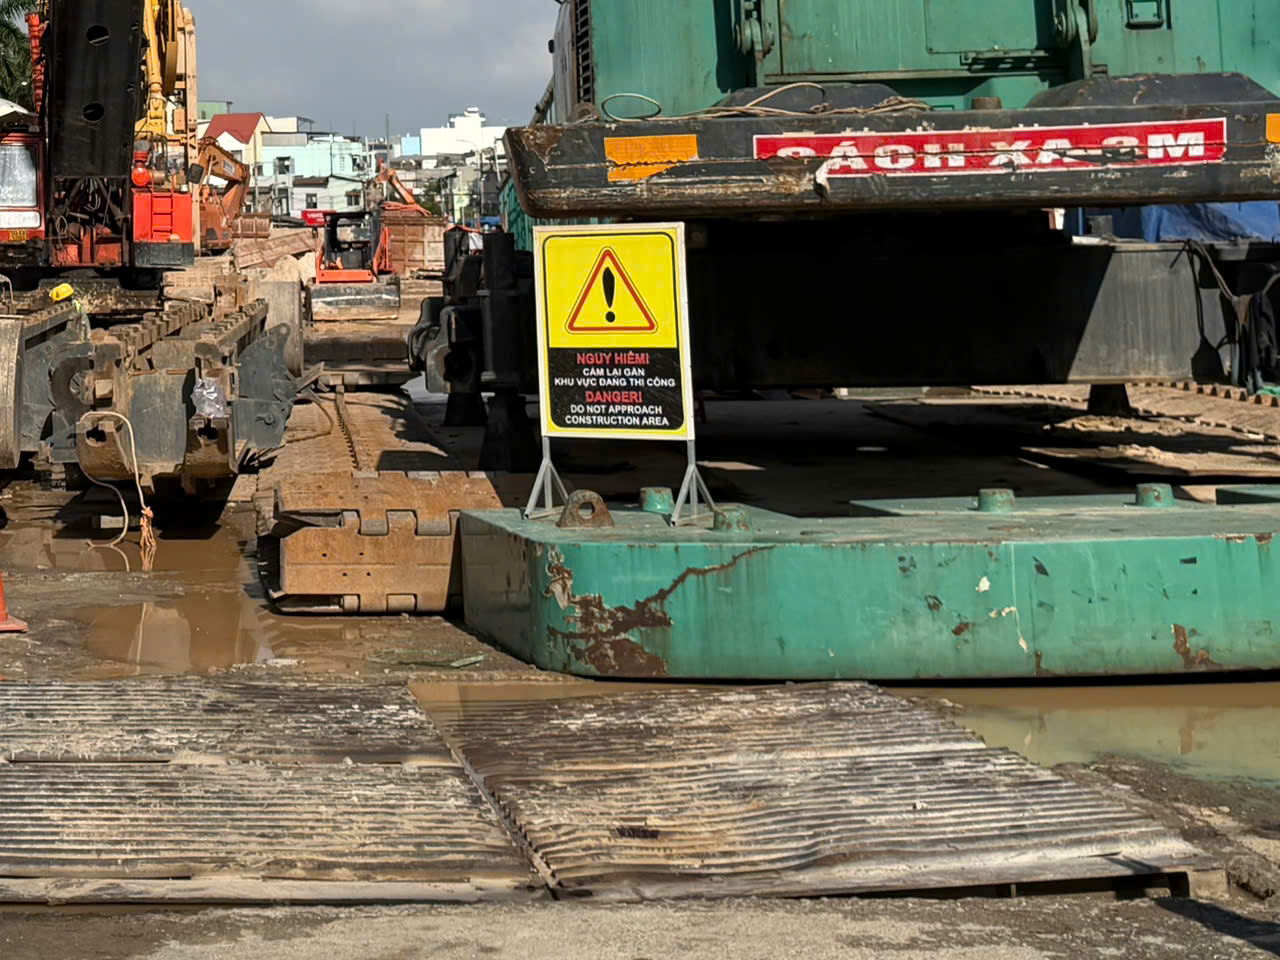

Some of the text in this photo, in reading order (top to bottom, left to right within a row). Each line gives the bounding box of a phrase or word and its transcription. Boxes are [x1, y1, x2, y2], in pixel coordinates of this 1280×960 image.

[576, 352, 612, 365] NGUY
[554, 377, 574, 386] KHU
[629, 378, 645, 387] THI
[646, 376, 676, 387] CÔNG
[585, 390, 643, 403] DANGER!
[570, 405, 663, 415] DO NOT APPROACH
[565, 415, 670, 427] CONSTRUCTION AREA
